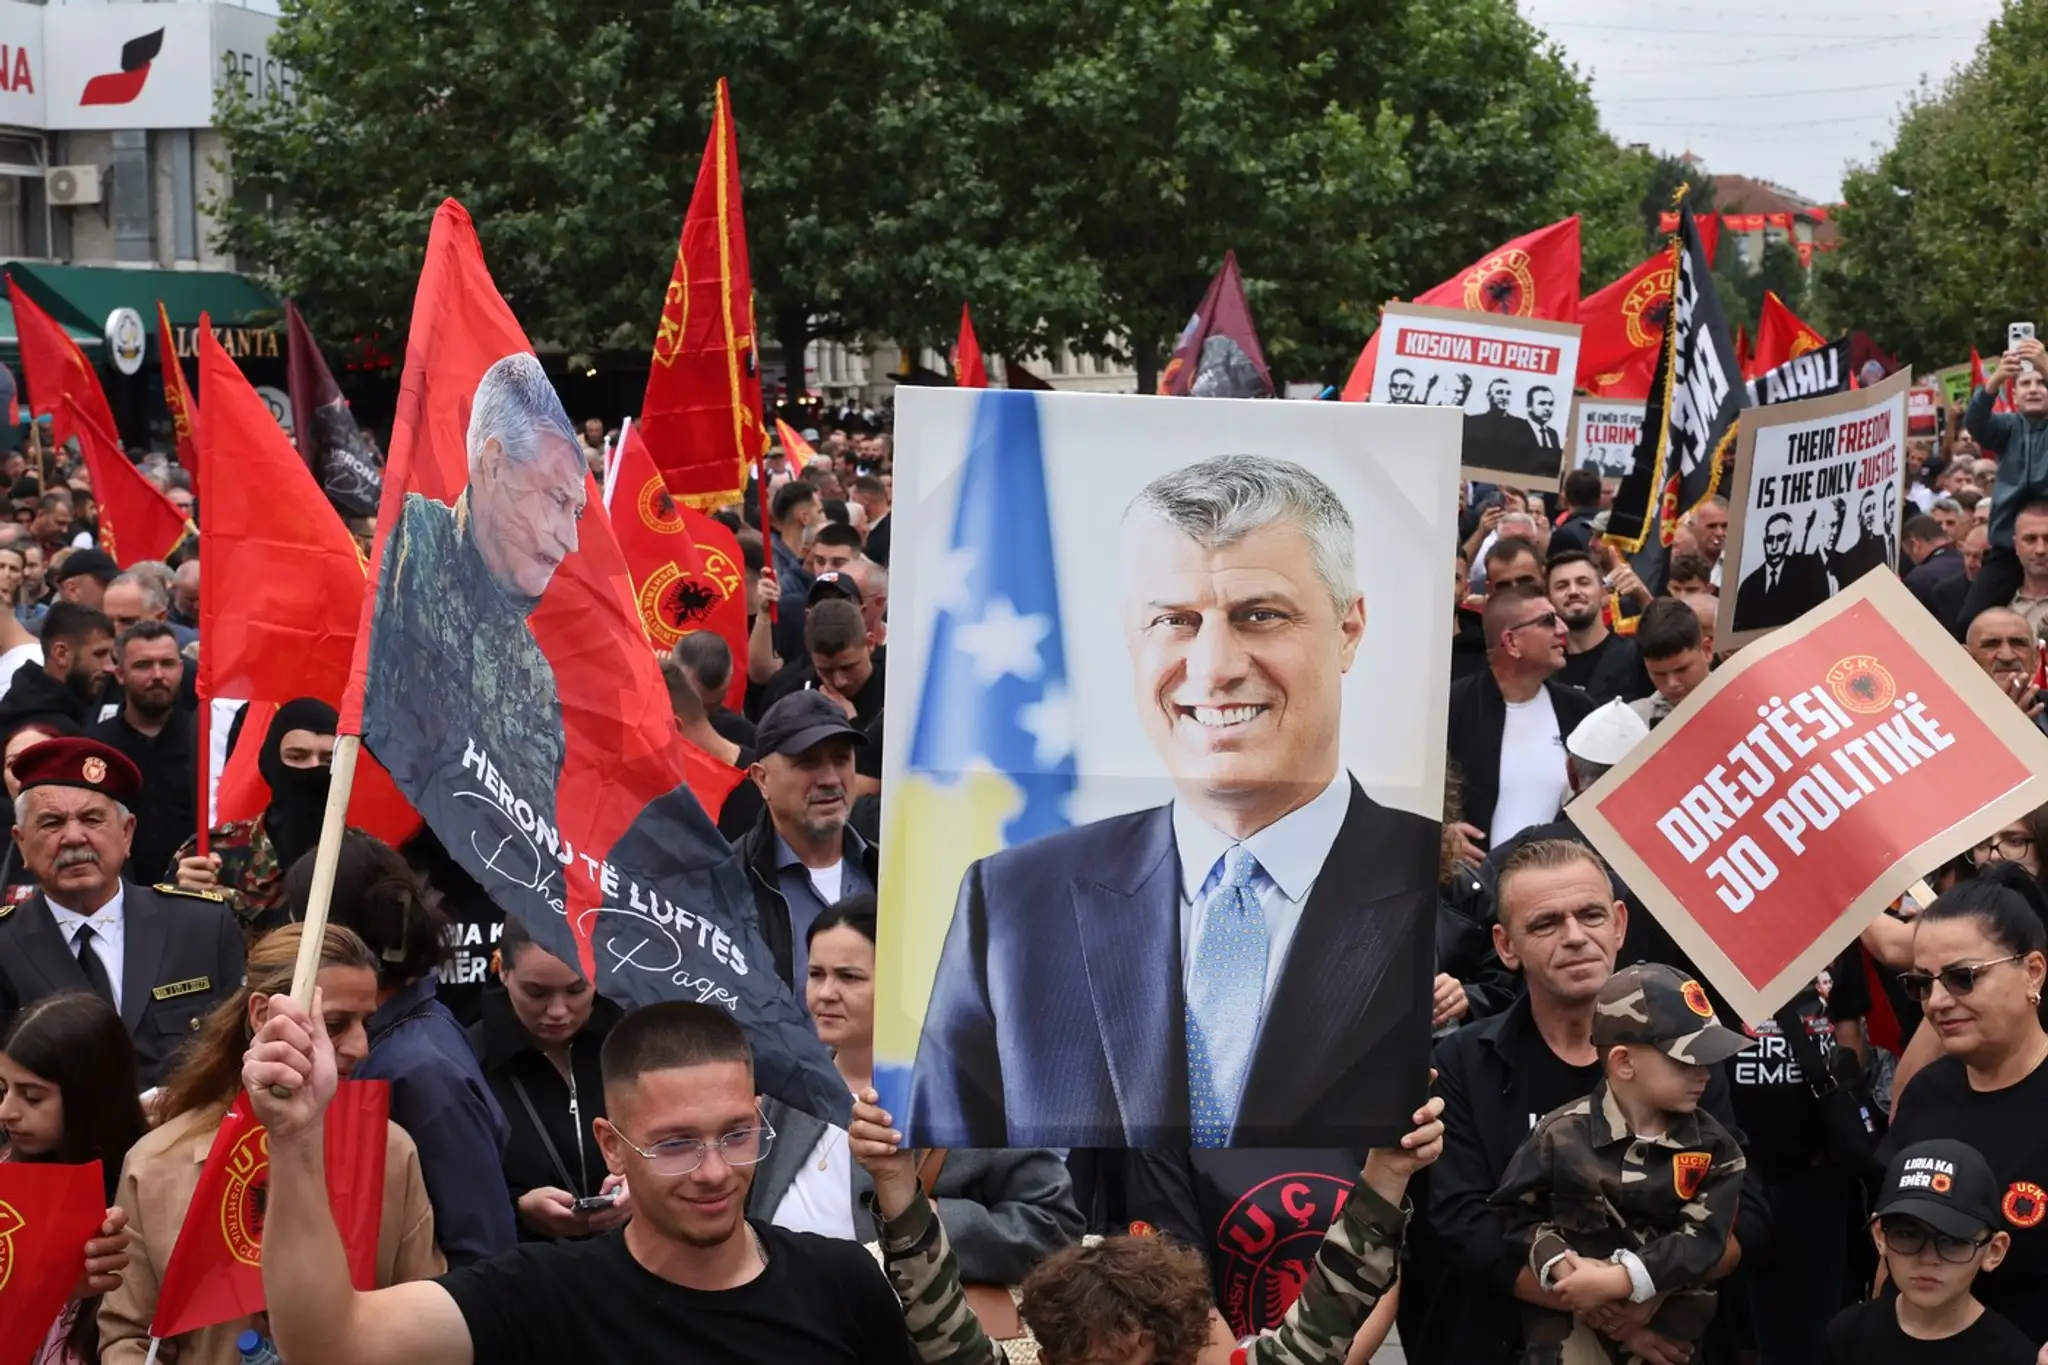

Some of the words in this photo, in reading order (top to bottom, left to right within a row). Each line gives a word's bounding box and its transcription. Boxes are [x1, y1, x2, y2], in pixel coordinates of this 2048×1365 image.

[1405, 331, 1472, 362] KOSOVA
[1477, 340, 1503, 365] PO
[1504, 343, 1551, 371] PRET
[1586, 424, 1637, 448] ÇLIRIM
[1788, 427, 1836, 466] THEIR
[1837, 409, 1892, 457] FREEDOM
[1757, 476, 1777, 510] IS
[1781, 470, 1814, 506] THE
[1816, 461, 1858, 500] ONLY
[1655, 685, 1853, 864] DREJTËSI
[462, 737, 574, 865] HERONJ
[579, 852, 620, 899] TË
[1706, 834, 1780, 914] JO
[1762, 691, 1956, 857] POLITIKË
[453, 791, 569, 915] Dhe
[1898, 1171, 1932, 1188] EMËR
[1904, 1158, 1934, 1171] LIRIA
[1934, 1159, 1953, 1176] KA
